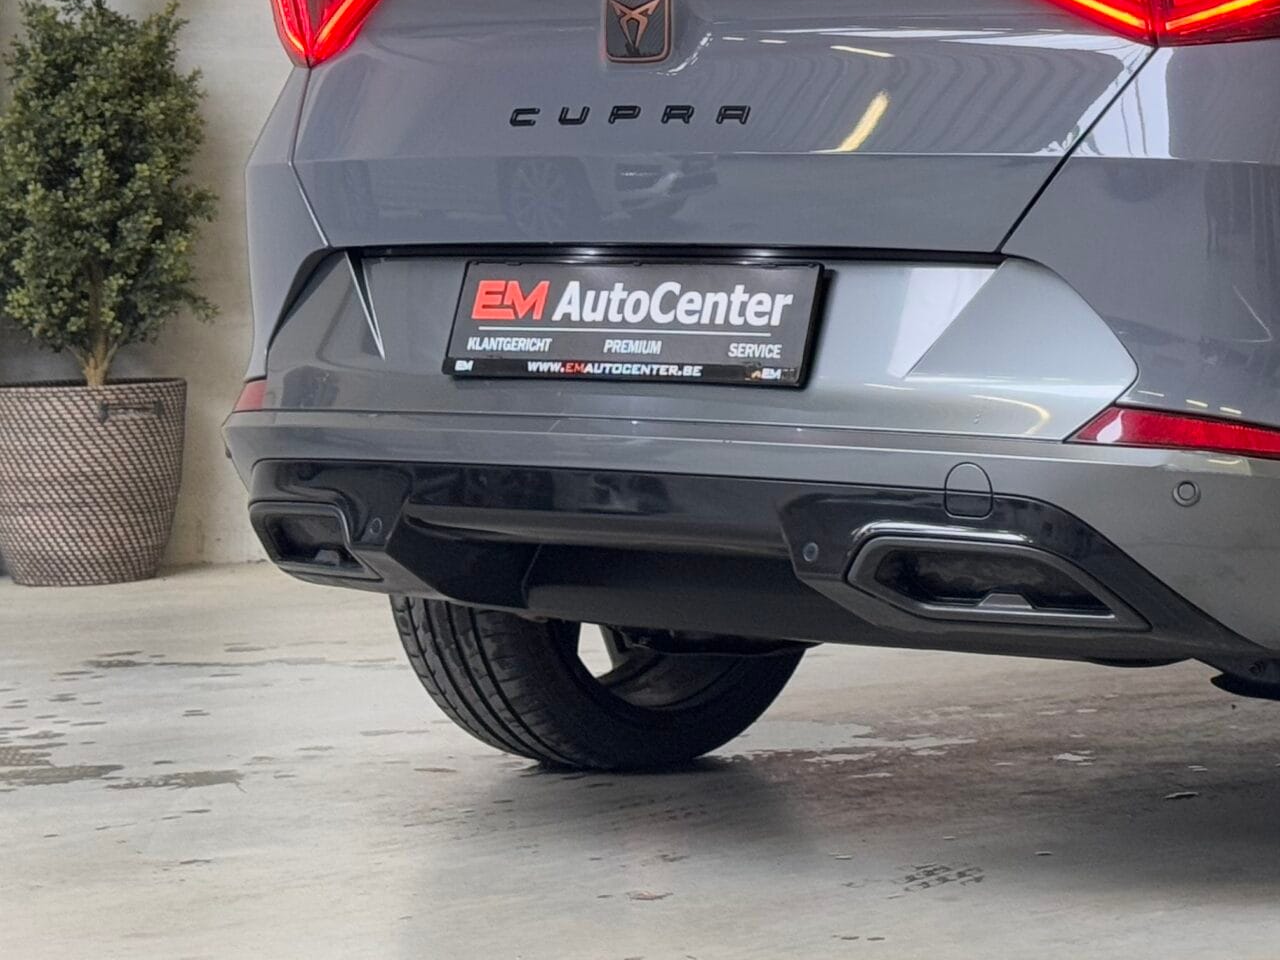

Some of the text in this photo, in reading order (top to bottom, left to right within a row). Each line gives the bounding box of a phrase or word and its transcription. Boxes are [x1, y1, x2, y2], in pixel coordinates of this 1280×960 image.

[509, 104, 752, 127] CUPRA
[471, 280, 794, 327] EM AutoCenter
[467, 337, 552, 352] KLANTGERICHT
[603, 339, 662, 355] PREMIUM
[728, 343, 782, 359] SERVICE
[527, 361, 703, 377] WWW.EMAUTOCENTER.BE
